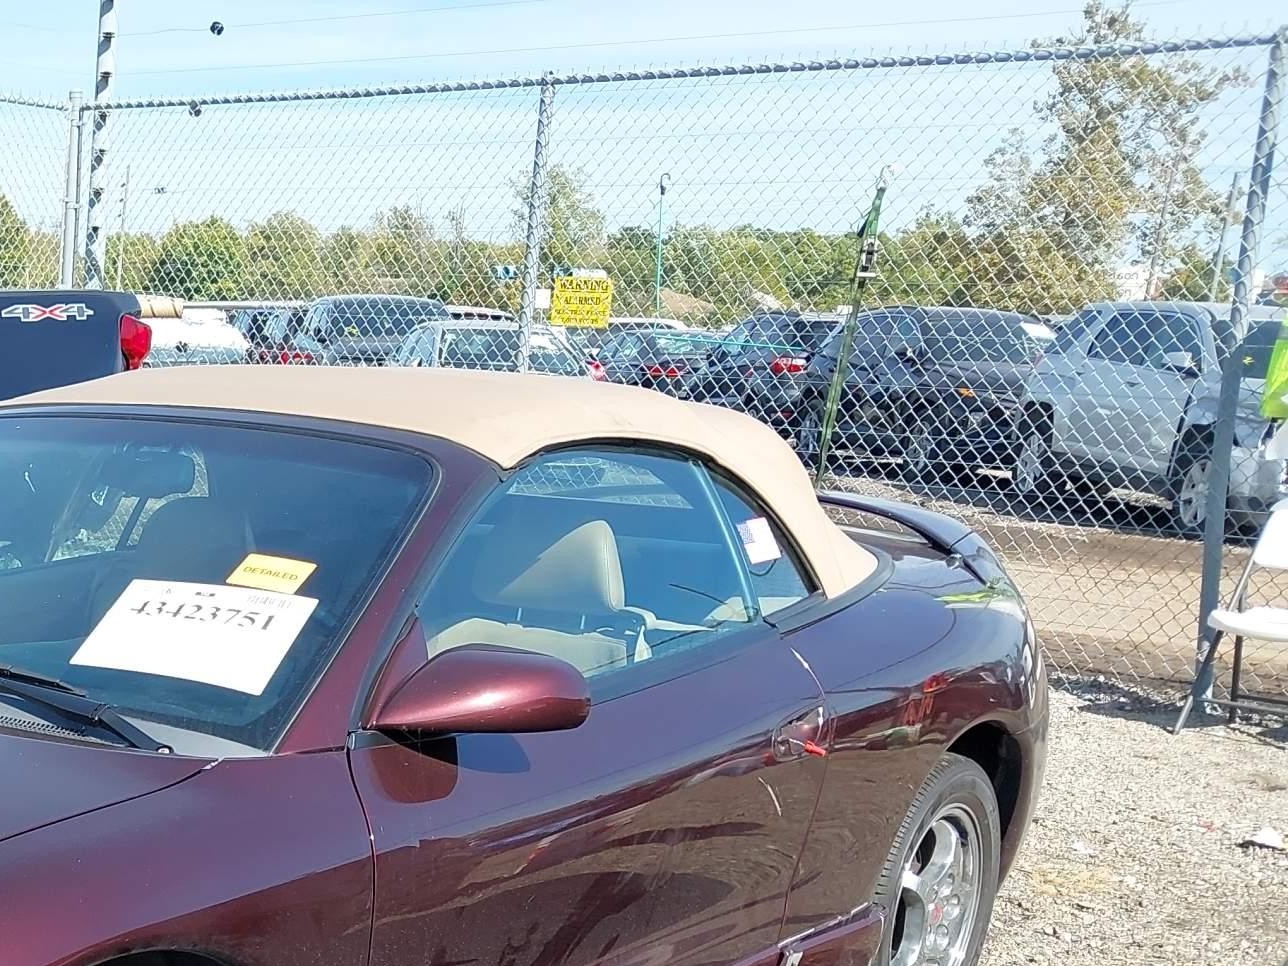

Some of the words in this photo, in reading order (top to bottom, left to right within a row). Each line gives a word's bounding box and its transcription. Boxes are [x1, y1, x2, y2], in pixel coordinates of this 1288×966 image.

[559, 279, 609, 291] WARNING
[242, 565, 299, 582] DETAILED
[128, 600, 276, 631] 43423751
